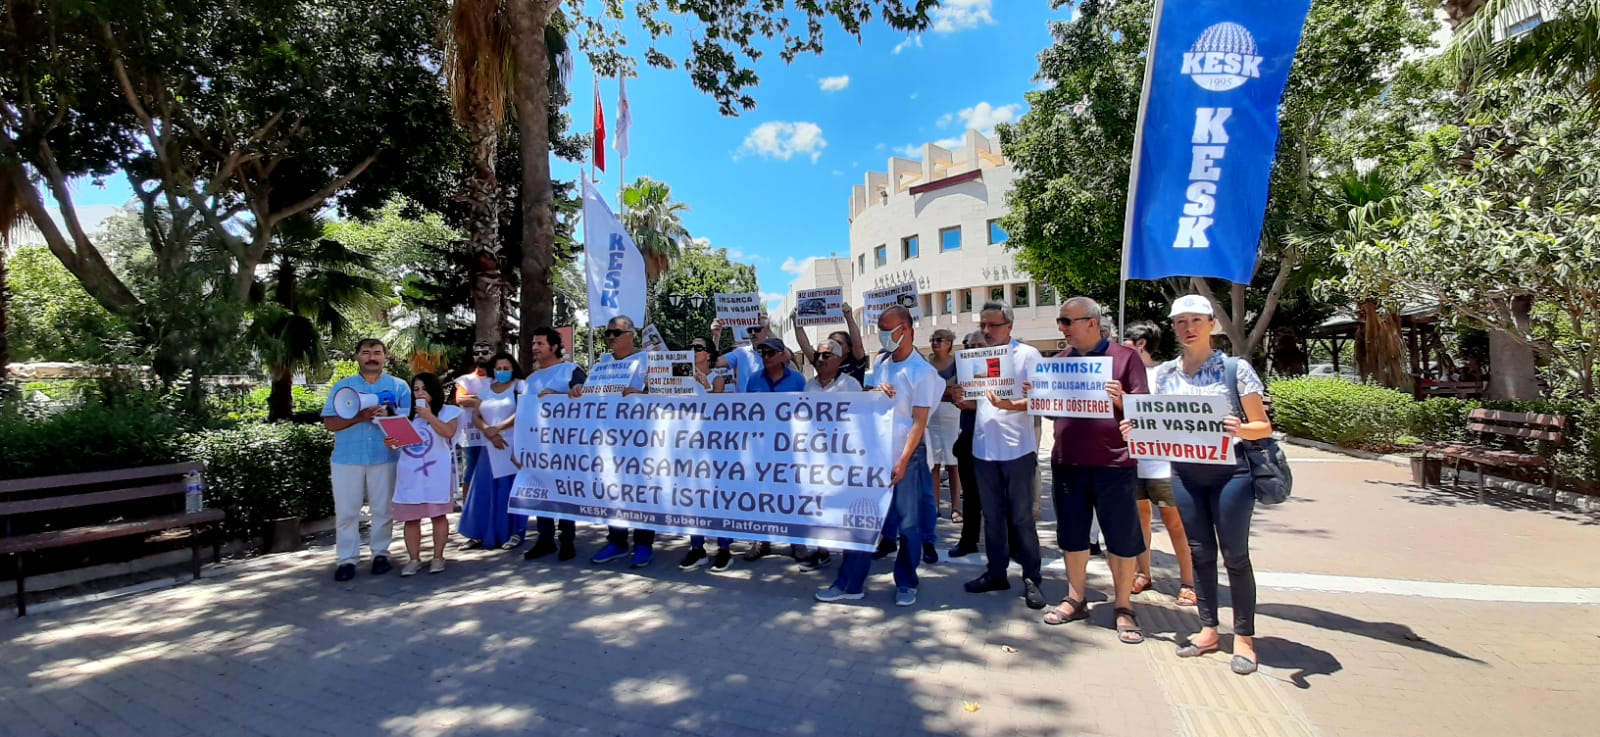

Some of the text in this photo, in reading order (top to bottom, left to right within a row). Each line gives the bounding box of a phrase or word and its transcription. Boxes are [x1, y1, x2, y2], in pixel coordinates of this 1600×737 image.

[1181, 52, 1264, 78] KESK
[1208, 77, 1233, 87] 1995
[1173, 107, 1233, 248] KESK
[601, 233, 626, 309] KESK
[731, 305, 760, 313] YAŞAM
[1036, 362, 1103, 374] AYRIMSIZ
[1031, 379, 1049, 389] TÜM
[540, 397, 852, 422] SAHTE RAKAMLARA GÖRE
[1030, 397, 1110, 413] 3600 EK GÖSTERGE
[1136, 400, 1214, 414] İNSANCA
[1130, 416, 1228, 433] BİR YAŞAM
[774, 428, 866, 456] DEĞİL,
[1130, 436, 1230, 460] İSTİYORUZ!
[520, 448, 604, 473] İNSANCA
[613, 456, 746, 480] YAŞAMAYA
[516, 487, 549, 499] KESK
[555, 477, 823, 516] BİR ÜCRET İSTİYORUZ!
[580, 506, 789, 534] KESK Antalya Şubeler Platformu
[843, 514, 883, 530] KESK
